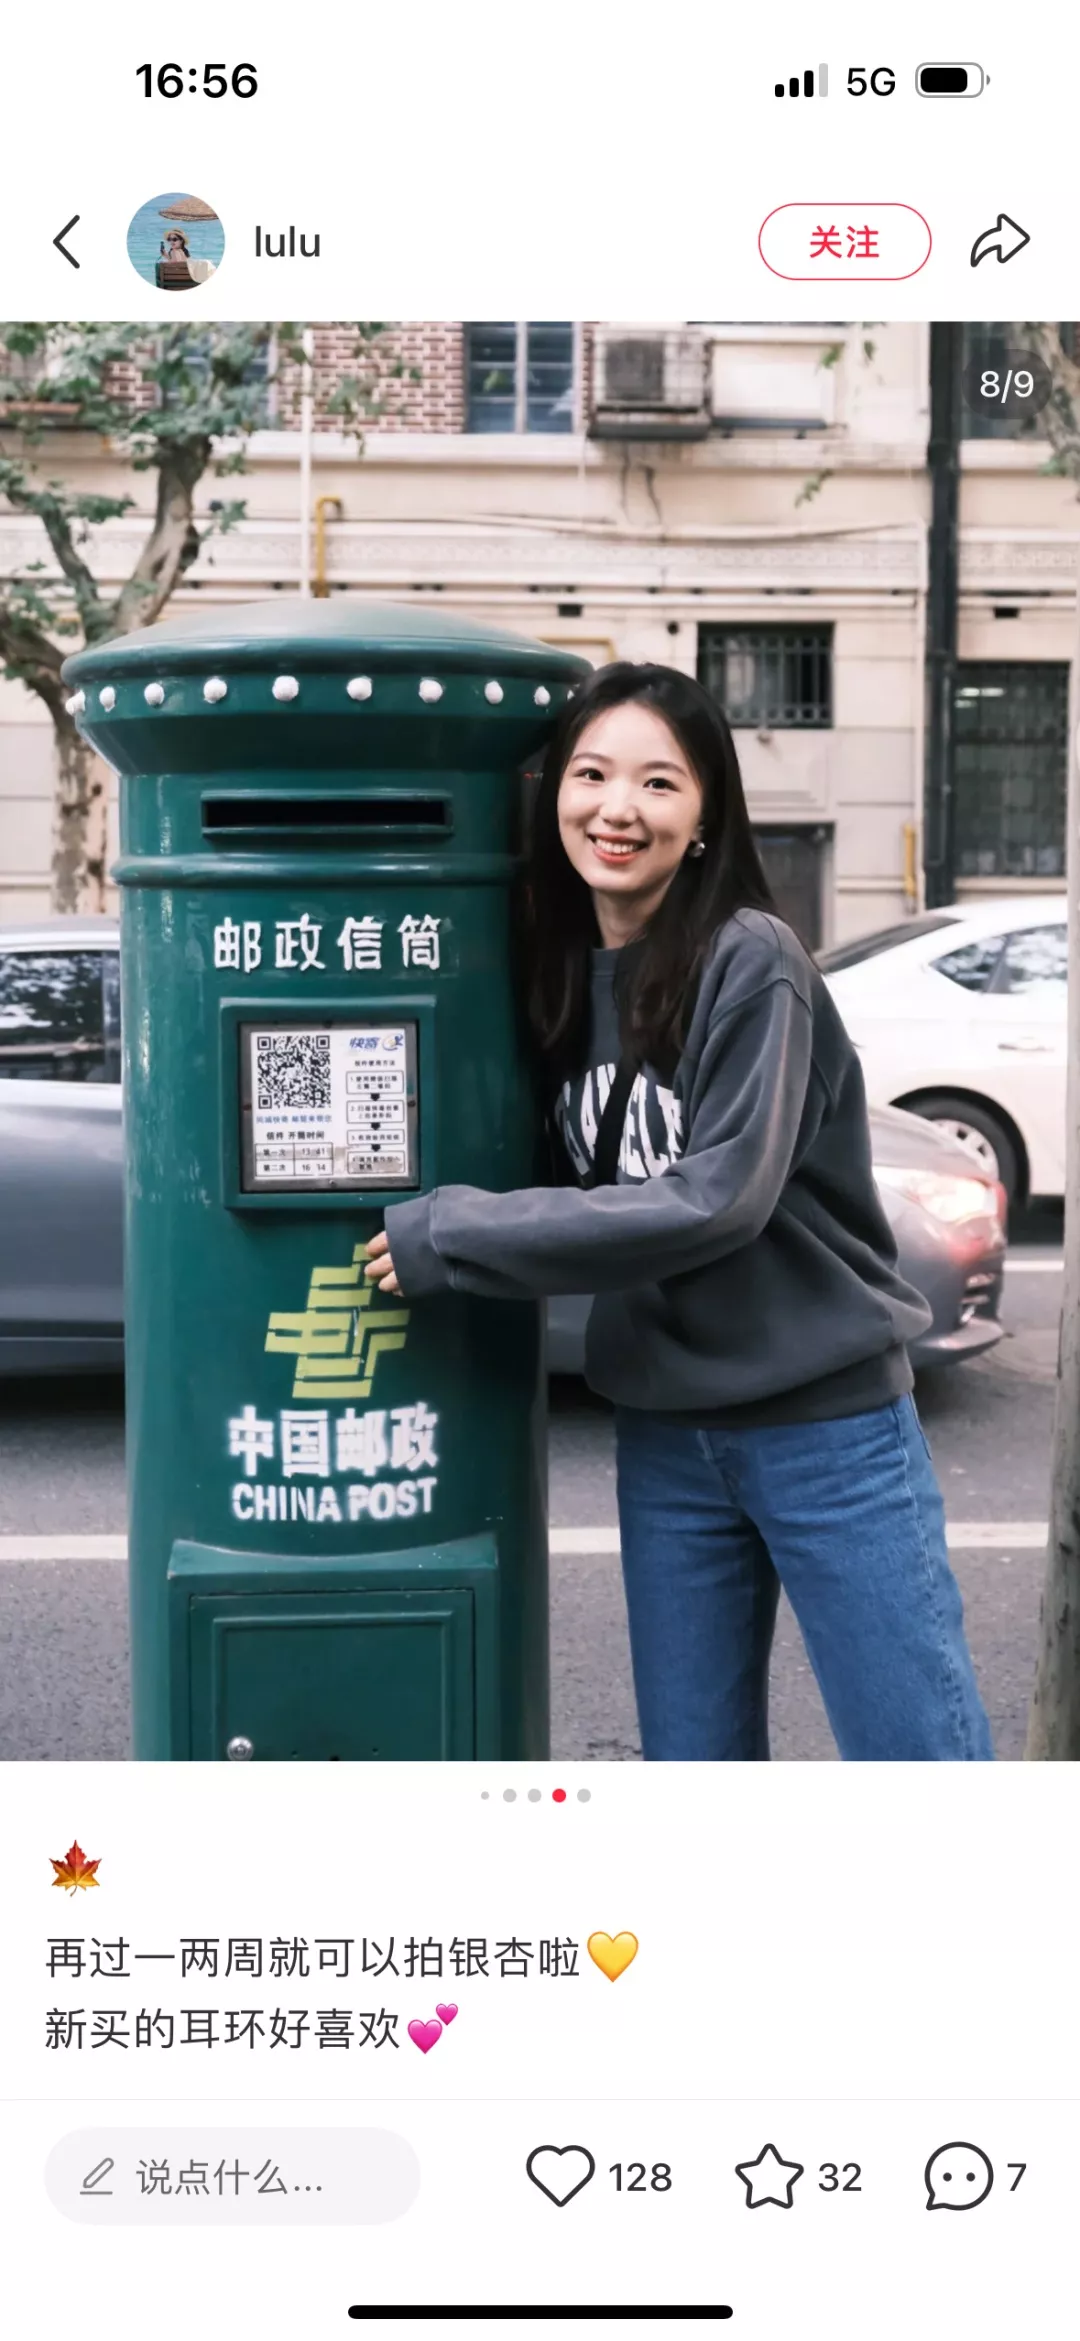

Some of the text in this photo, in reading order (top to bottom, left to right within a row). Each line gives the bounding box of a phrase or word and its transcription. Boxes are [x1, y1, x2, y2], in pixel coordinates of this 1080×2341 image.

[213, 912, 441, 973] 邮政信筒
[228, 1401, 439, 1479] 中国邮政
[231, 1475, 438, 1523] CHINA POST
